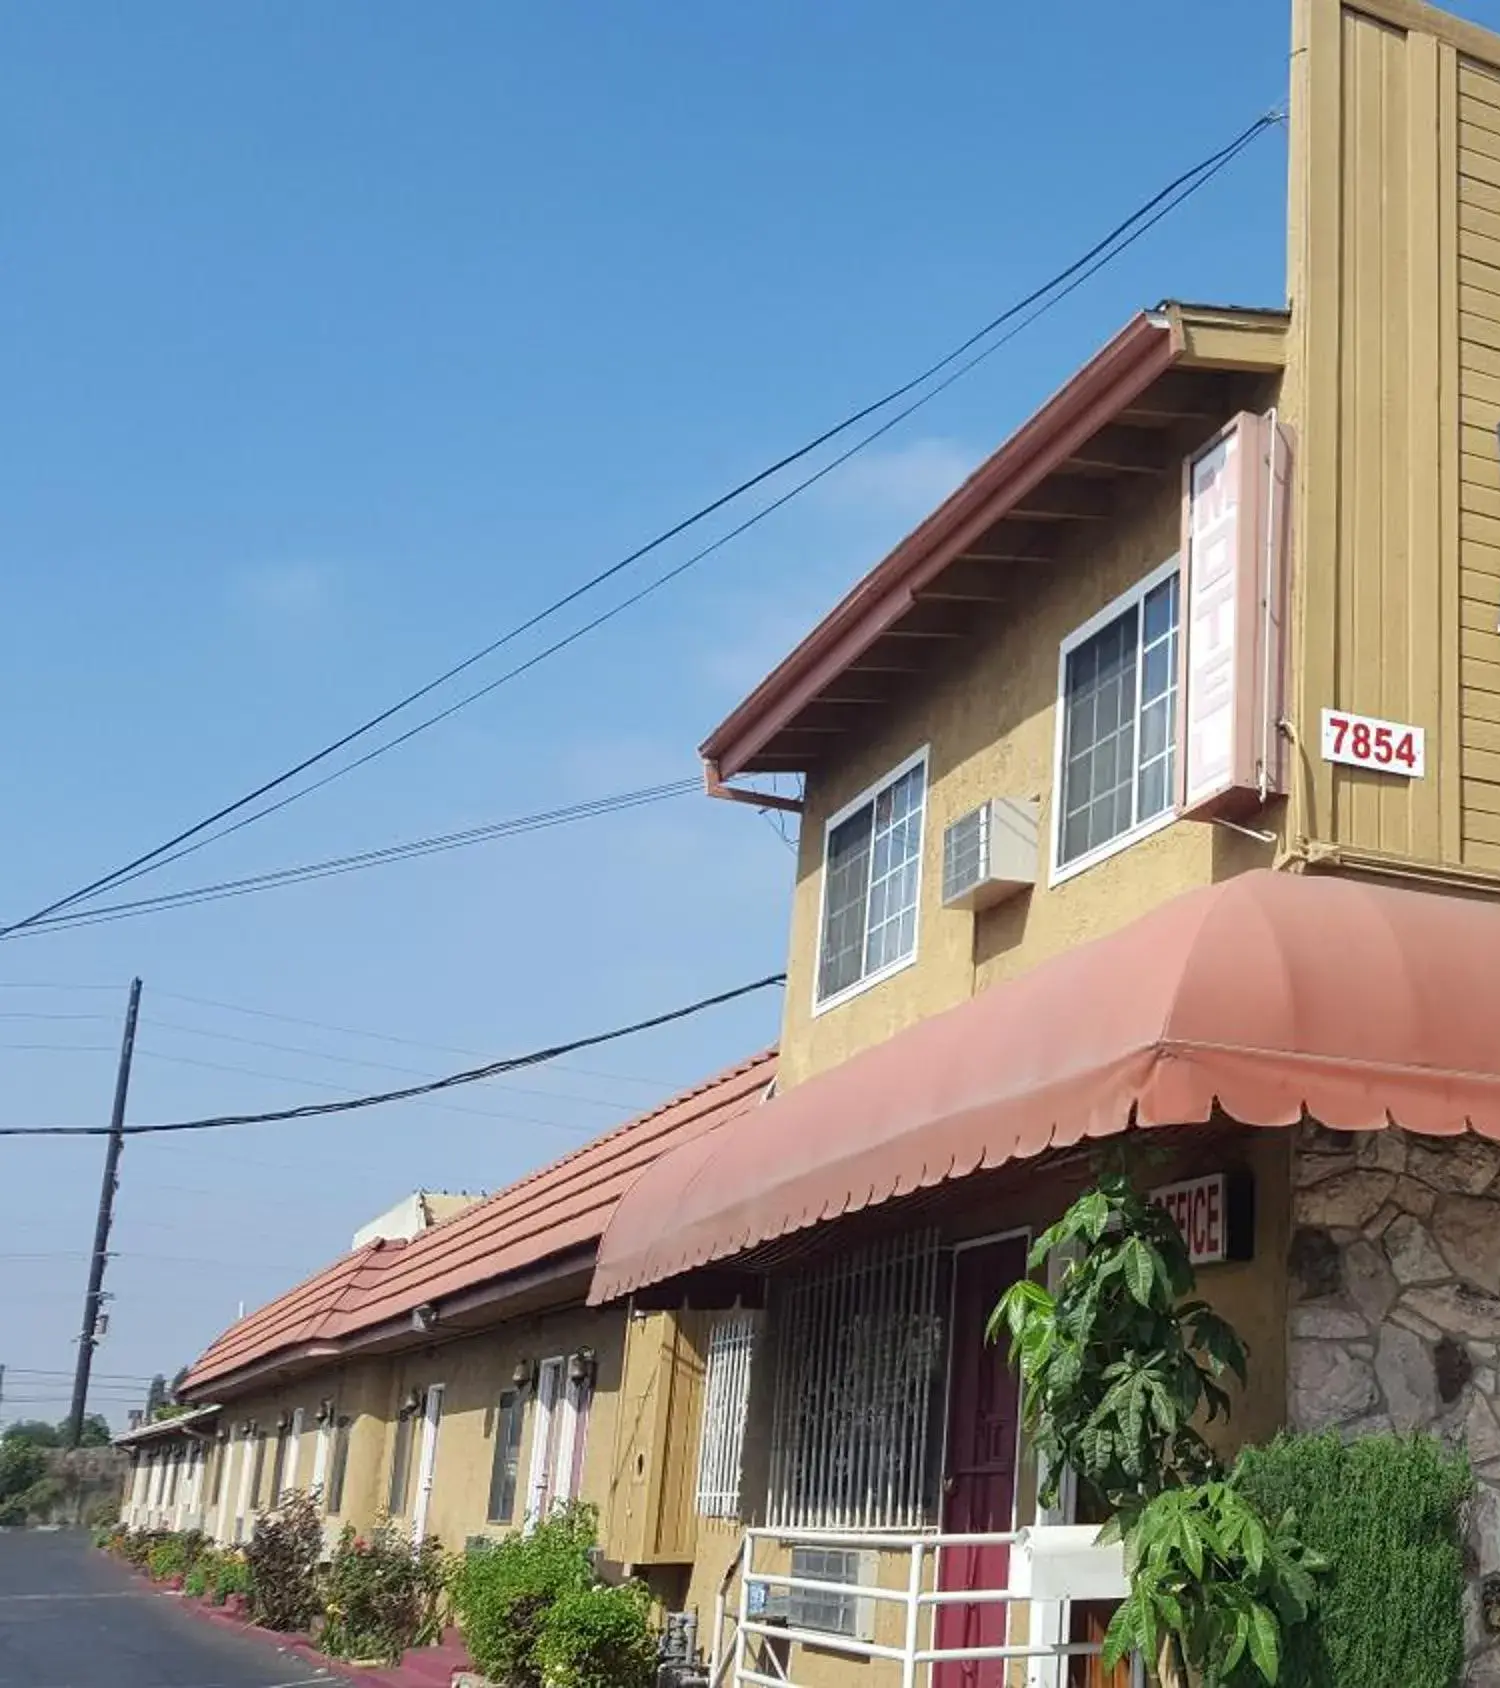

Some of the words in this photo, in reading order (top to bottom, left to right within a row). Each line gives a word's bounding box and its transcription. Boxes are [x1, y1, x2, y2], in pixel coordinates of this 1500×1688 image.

[1193, 450, 1237, 791] MOTEL
[1328, 716, 1418, 769] 7854
[1152, 1183, 1220, 1255] FICE
